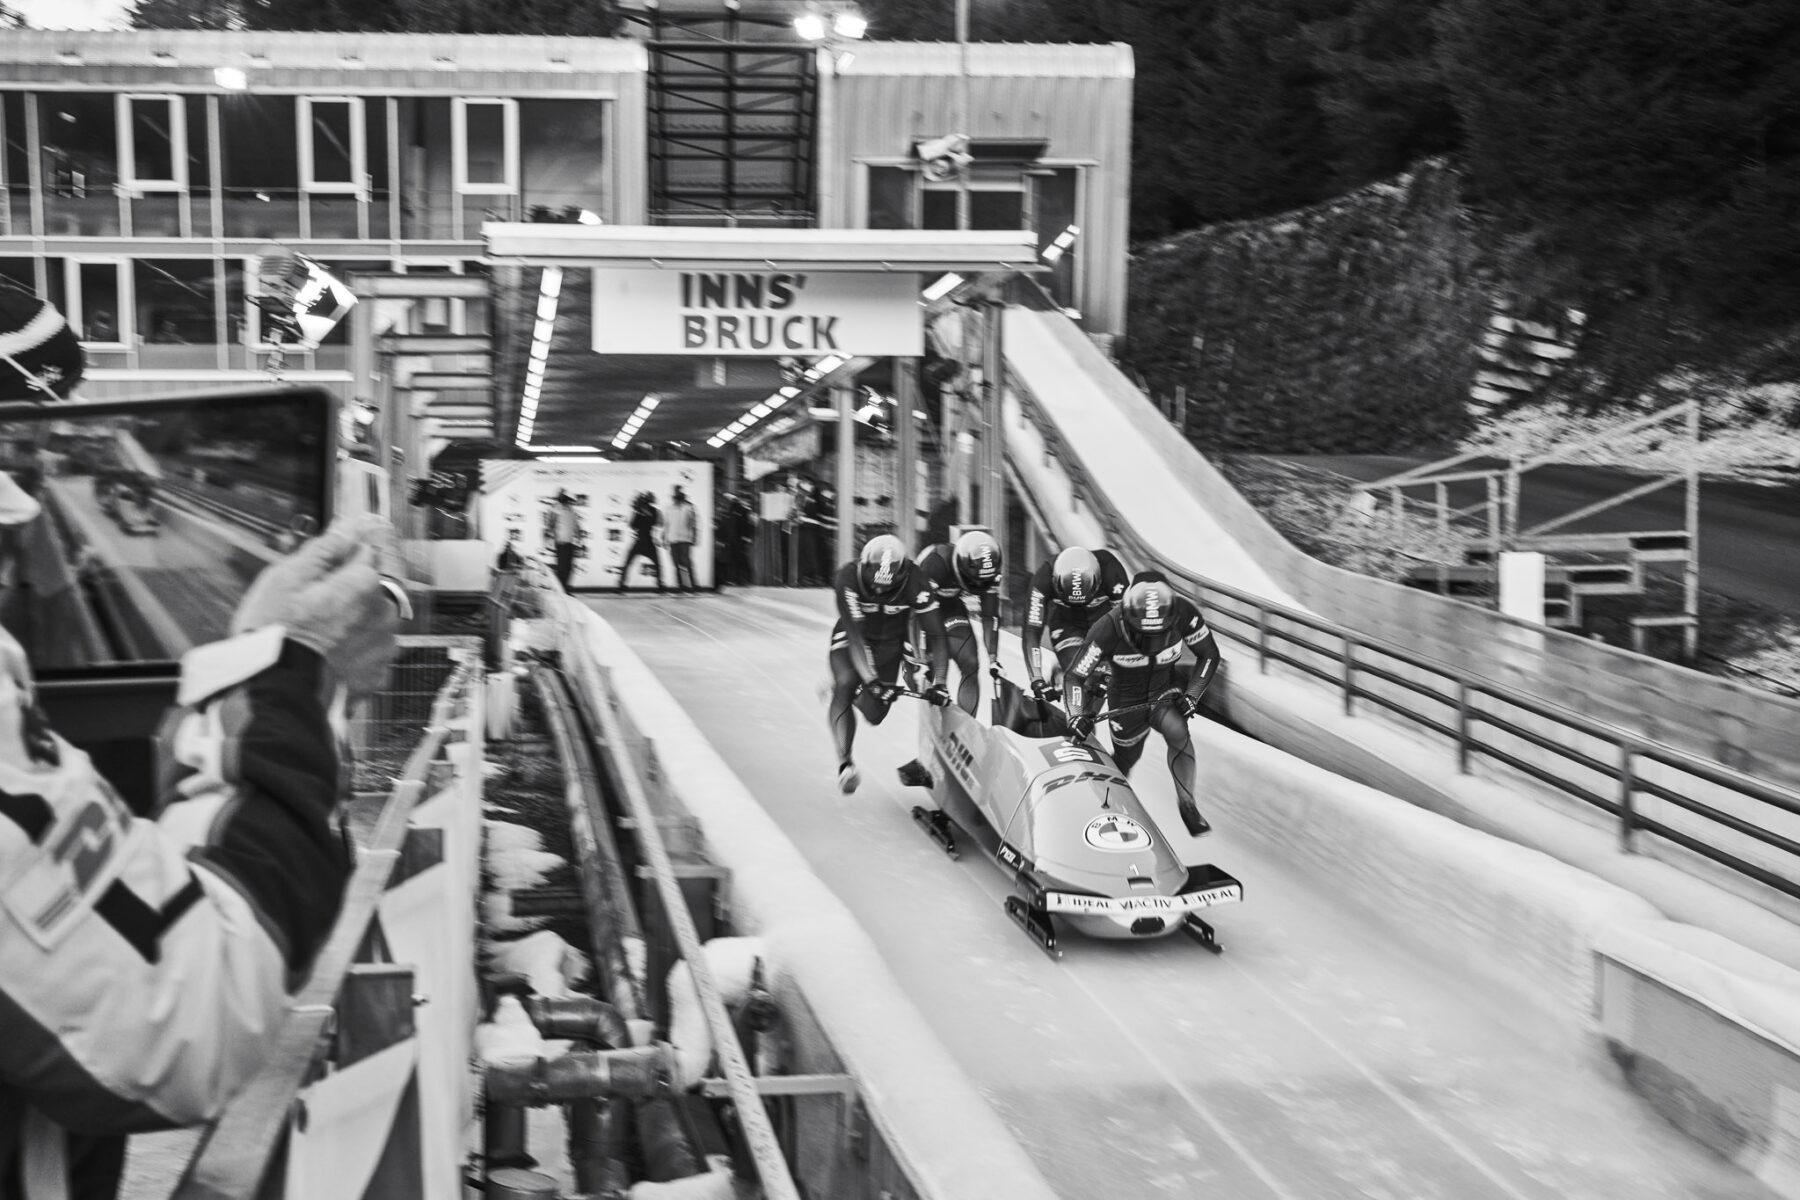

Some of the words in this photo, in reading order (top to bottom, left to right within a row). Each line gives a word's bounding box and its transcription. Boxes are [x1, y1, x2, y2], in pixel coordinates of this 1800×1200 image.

[684, 315, 839, 350] BRUCK
[1072, 572, 1081, 596] BMW
[1145, 590, 1160, 618] BMW
[1072, 898, 1112, 908] IDEAL
[1119, 898, 1172, 910] VIACTIV
[1197, 888, 1236, 902] IDEAL
